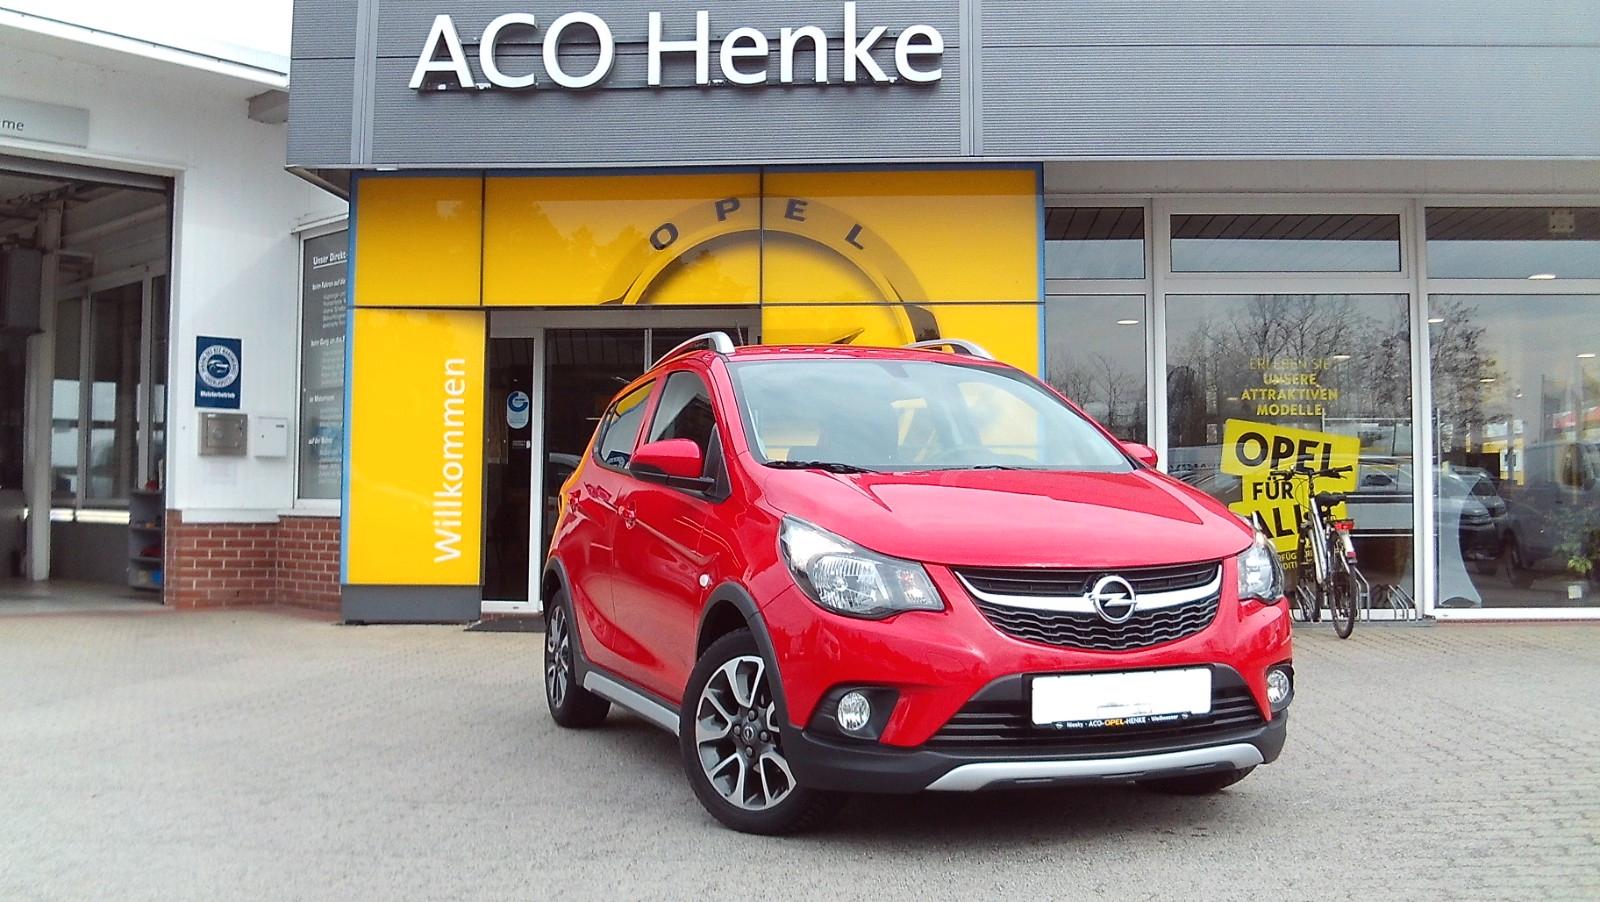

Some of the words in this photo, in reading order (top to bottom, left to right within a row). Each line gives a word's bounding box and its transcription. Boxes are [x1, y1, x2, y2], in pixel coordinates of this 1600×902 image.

[409, 11, 615, 90] ACO
[647, 1, 945, 86] Henke
[650, 197, 864, 250] OPEL
[1263, 373, 1317, 385] UNSERE
[1313, 359, 1329, 370] SIE
[1241, 388, 1339, 400] ATTRAKTIVEN
[433, 357, 466, 563] Willkommen
[1235, 432, 1336, 472] OPEL
[1252, 477, 1294, 500] FÜR
